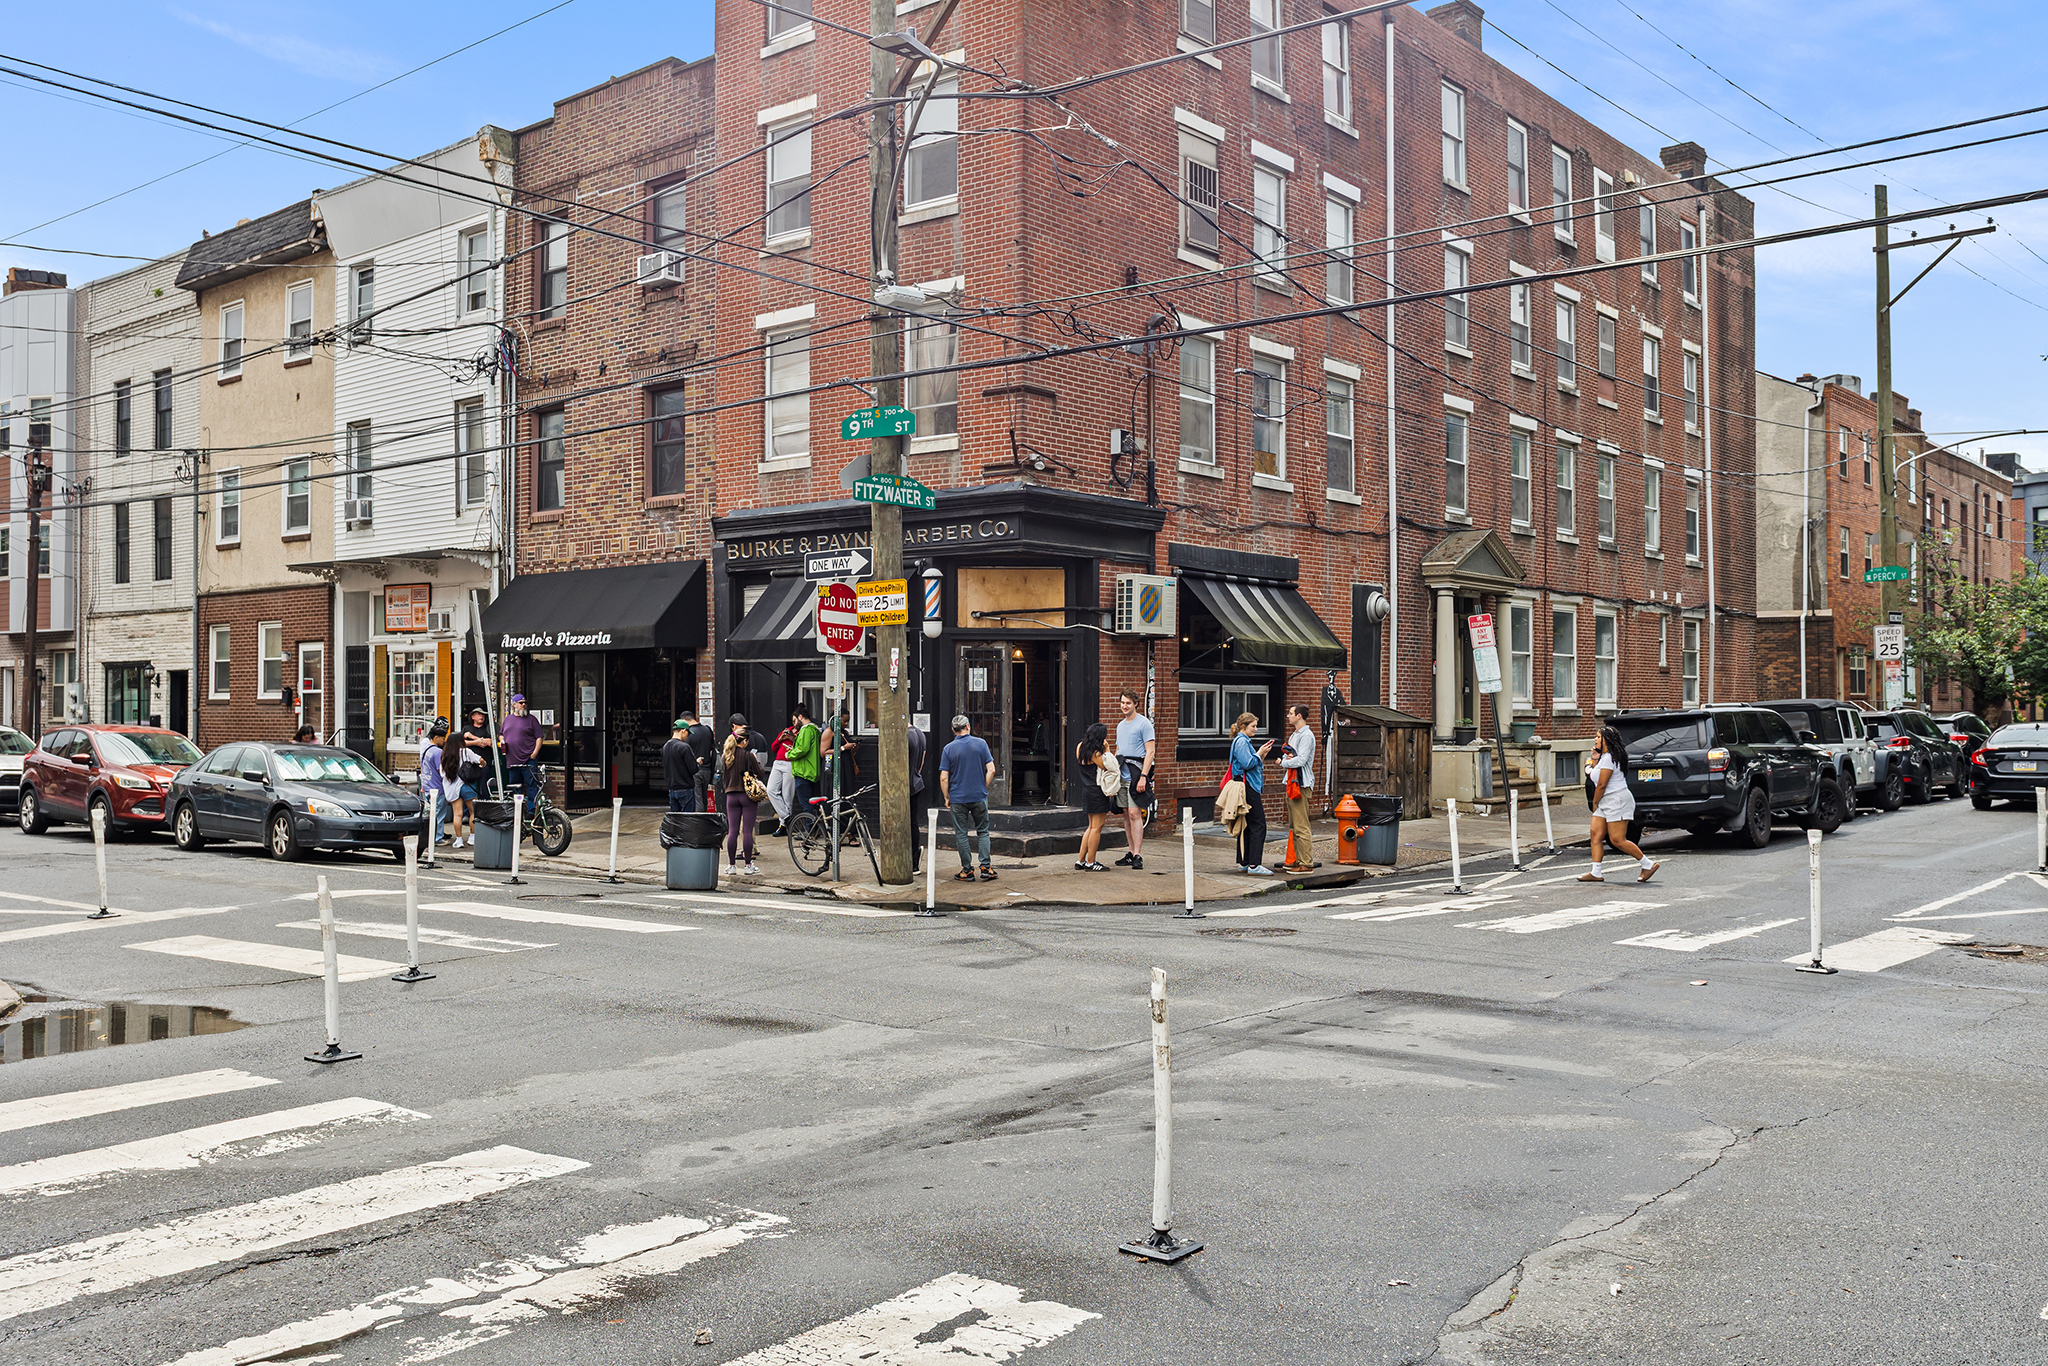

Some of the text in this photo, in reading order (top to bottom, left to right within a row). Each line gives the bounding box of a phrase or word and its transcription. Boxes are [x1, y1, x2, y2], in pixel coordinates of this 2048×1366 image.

[860, 411, 873, 419] 799
[874, 409, 881, 418] S
[849, 419, 910, 437] 9TH ST
[894, 478, 901, 486] W
[855, 481, 935, 507] FITZWATER ST
[727, 538, 795, 560] BURKE
[799, 537, 812, 554] &
[816, 531, 873, 551] PAYN
[903, 524, 973, 544] ARBER
[811, 557, 851, 572] ONE WAY
[1873, 571, 1897, 581] PERCY
[859, 584, 904, 594] Drive CarePhilly
[824, 595, 857, 609] DO NOT
[858, 596, 904, 610] SPEED 25 LIMIT
[860, 613, 905, 623] Watch Children
[827, 627, 854, 640] ENTER
[501, 631, 612, 651] Angelo's Pizzeria
[1880, 643, 1899, 656] 25
